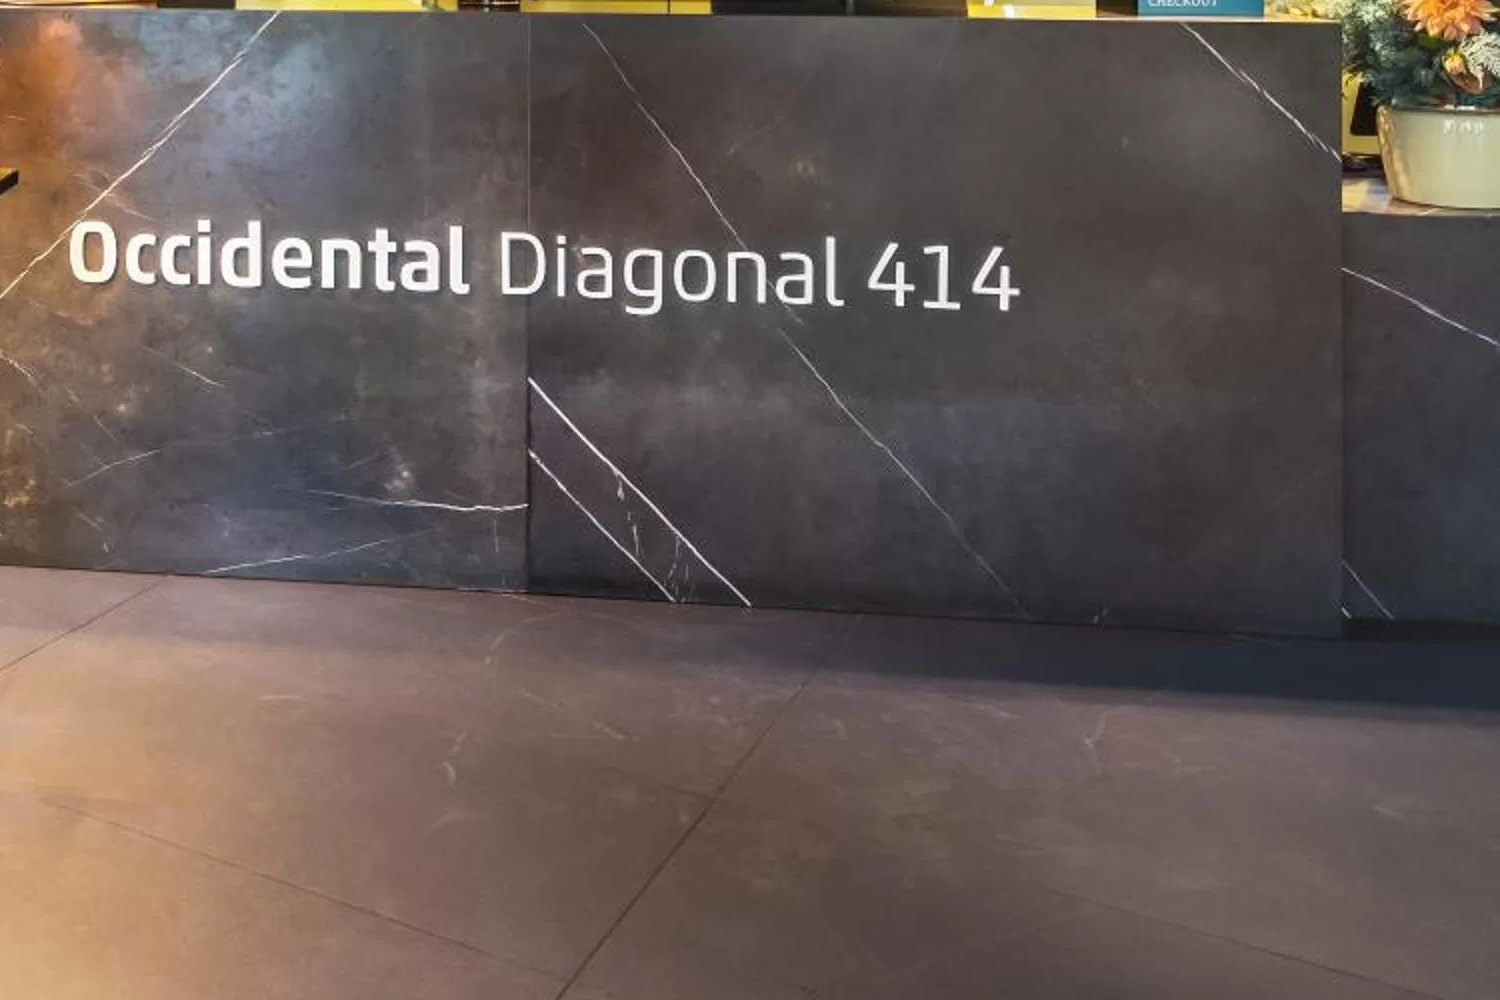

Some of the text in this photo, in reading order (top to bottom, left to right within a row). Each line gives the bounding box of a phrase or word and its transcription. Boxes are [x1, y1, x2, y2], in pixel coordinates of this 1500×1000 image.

[68, 218, 1021, 316] Occidental Diagonal 414
